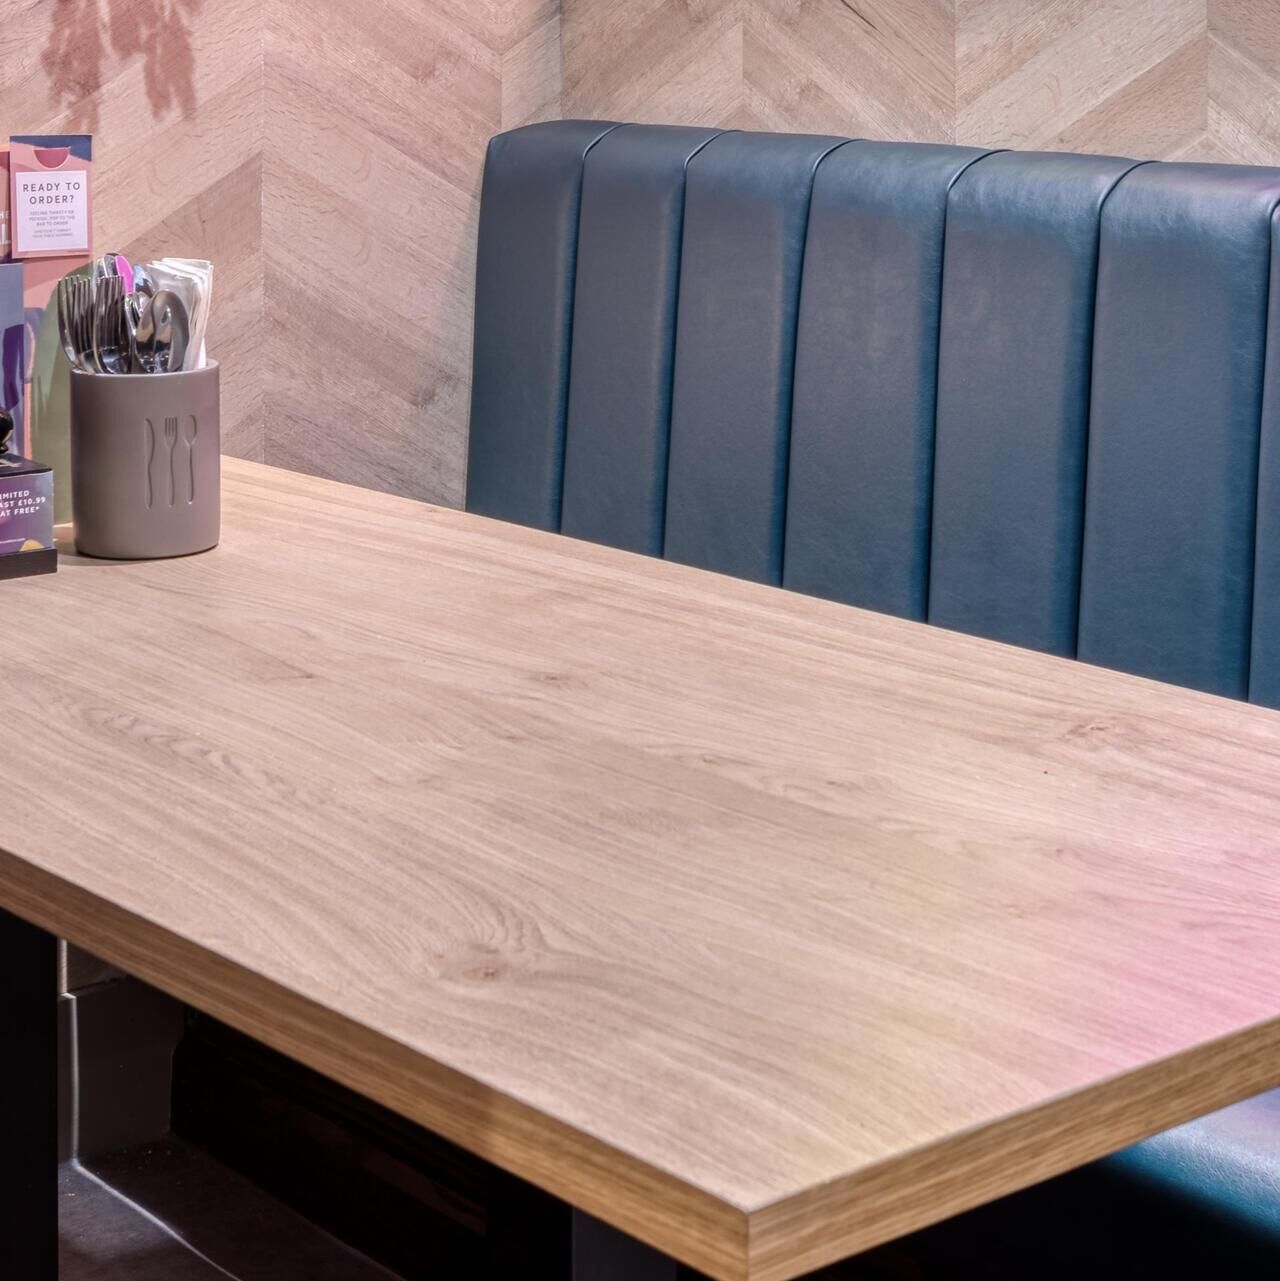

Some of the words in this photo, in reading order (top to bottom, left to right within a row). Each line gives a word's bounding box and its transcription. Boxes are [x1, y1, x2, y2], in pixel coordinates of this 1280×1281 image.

[23, 183, 60, 192] READY
[66, 182, 81, 191] TO
[29, 195, 74, 205] ORDER?
[17, 496, 47, 506] £10.99
